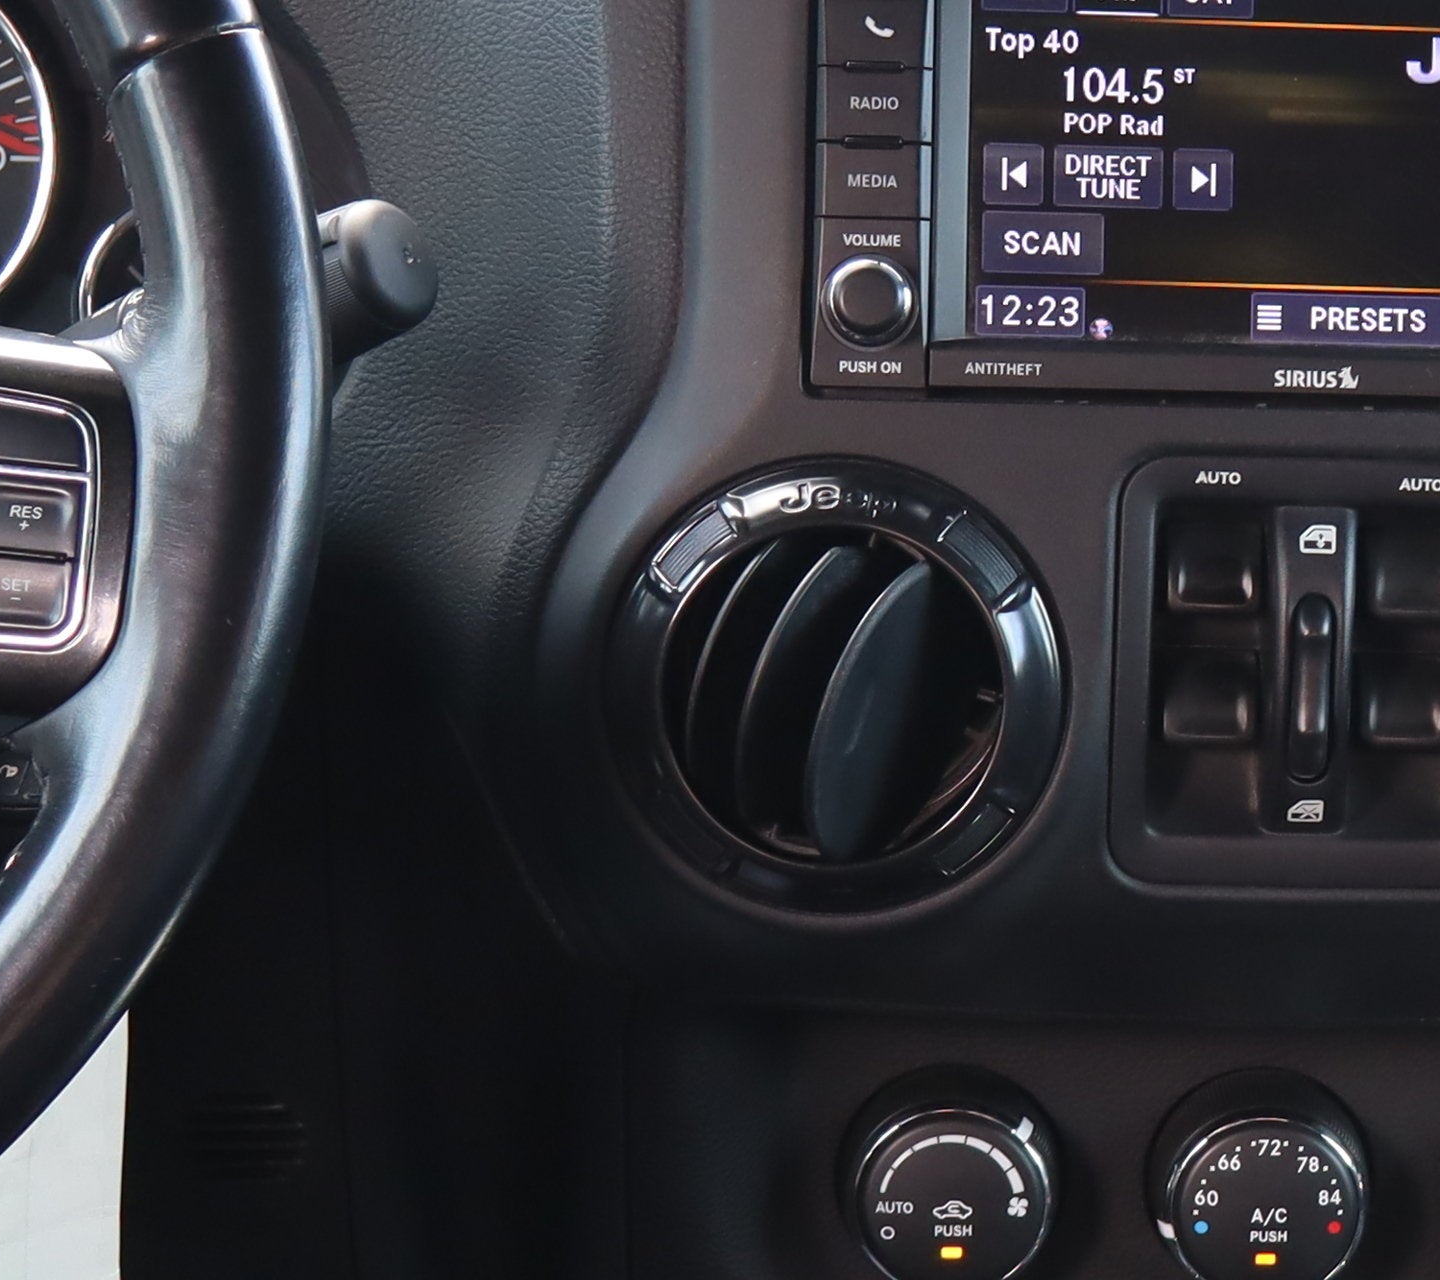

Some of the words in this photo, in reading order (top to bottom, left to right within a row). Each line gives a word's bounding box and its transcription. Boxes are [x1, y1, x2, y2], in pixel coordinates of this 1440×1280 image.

[985, 27, 1036, 58] Top
[1043, 29, 1080, 54] 40
[1063, 66, 1165, 105] 104.5
[1173, 68, 1196, 84] ST
[850, 96, 899, 111] RADIO
[1063, 112, 1113, 134] POP
[1119, 114, 1164, 137] Rad
[1064, 154, 1153, 179] DIRECT
[847, 174, 898, 189] MEDIA
[1075, 176, 1142, 203] TUNE
[842, 233, 902, 248] VOLUME
[1003, 230, 1081, 256] SCAN
[980, 293, 1080, 327] 12:23
[1309, 305, 1427, 333] PRESETS
[839, 360, 878, 374] PUSH
[880, 361, 902, 374] ON
[964, 361, 1043, 376] ANTITHEFT
[1273, 369, 1338, 389] SIRIUS
[1195, 470, 1242, 486] AUTO
[9, 504, 43, 521] RES
[0, 578, 32, 593] SET
[1257, 1139, 1282, 1157] 72
[1217, 1153, 1242, 1171] 66
[1296, 1156, 1320, 1174] 78
[1194, 1189, 1219, 1207] 60
[1317, 1189, 1343, 1207] 84
[874, 1200, 914, 1215] AUTO
[1250, 1207, 1288, 1227] A/C
[933, 1224, 973, 1237] PUSH
[1249, 1230, 1288, 1243] PUSH
